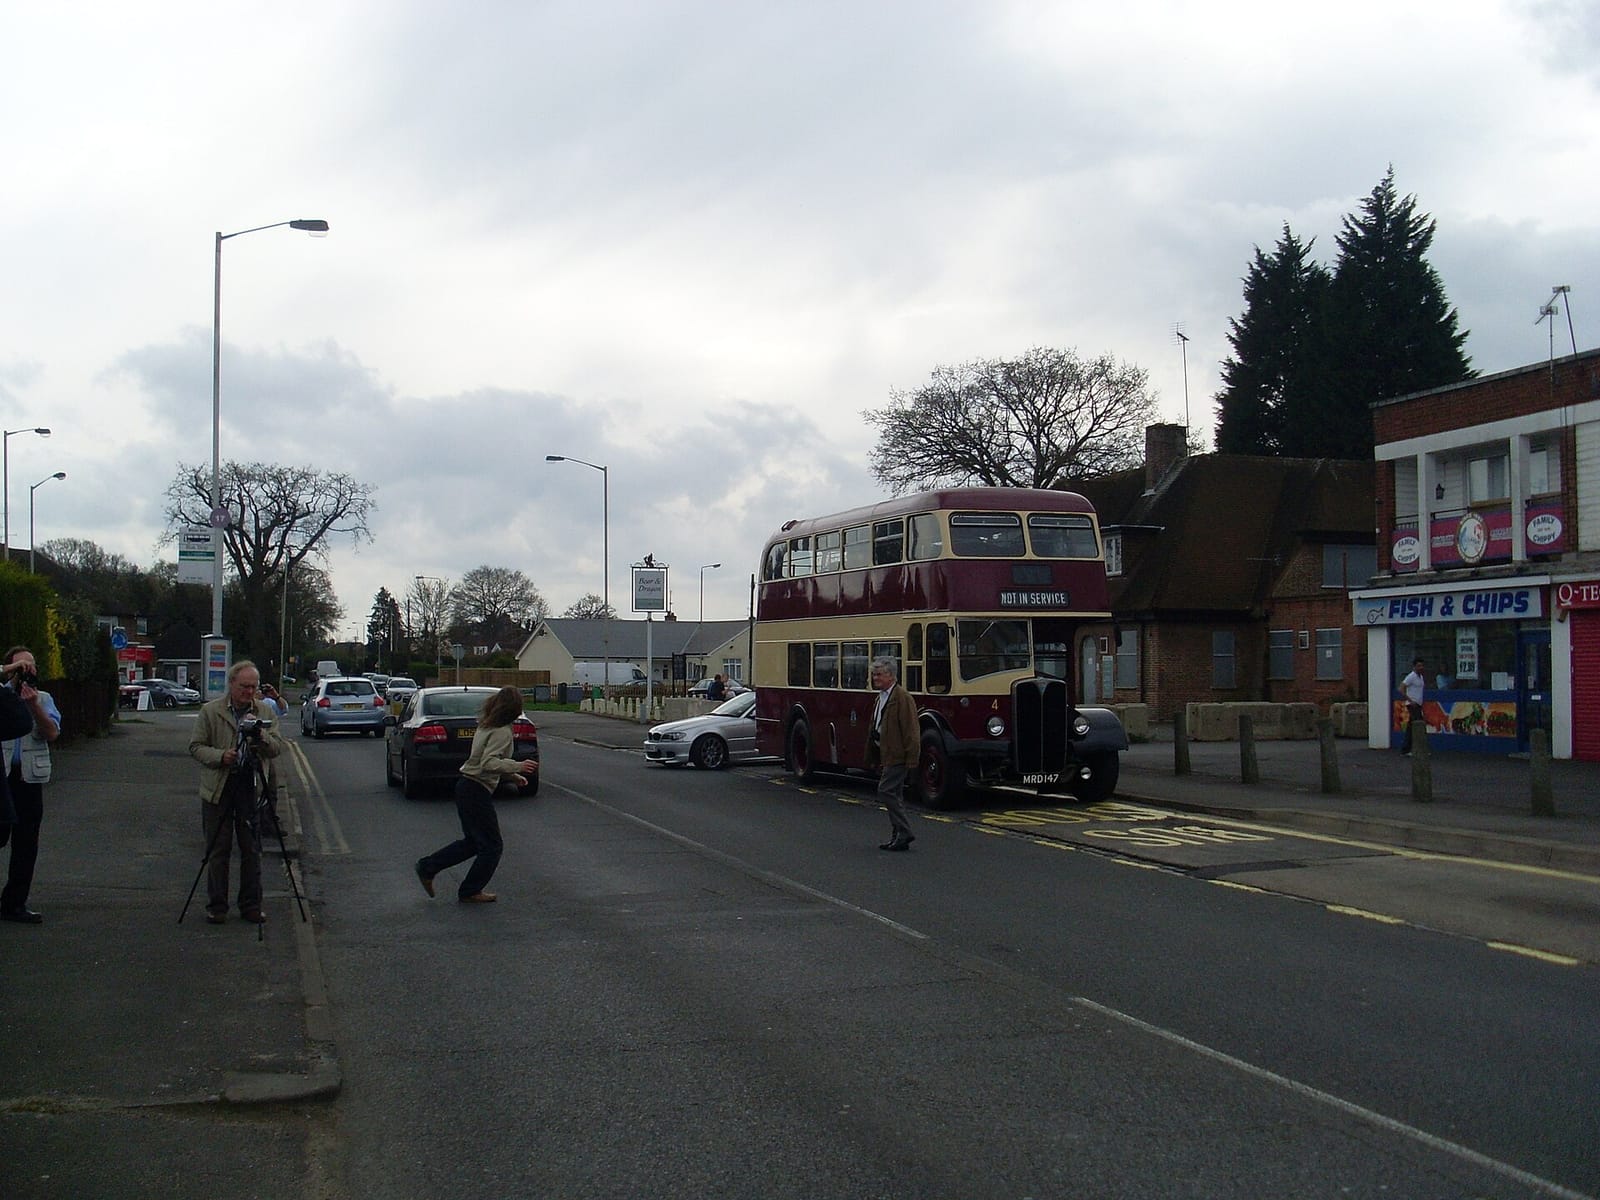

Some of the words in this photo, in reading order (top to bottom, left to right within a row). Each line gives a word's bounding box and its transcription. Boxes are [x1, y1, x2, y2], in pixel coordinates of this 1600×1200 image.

[1533, 516, 1555, 528] FAMILY
[1001, 592, 1016, 604] NOT
[1019, 592, 1028, 604] IN
[1030, 592, 1067, 604] SERVICE
[1558, 583, 1600, 606] Q-TE
[1388, 597, 1434, 619] FISH
[1440, 595, 1454, 617] &
[1462, 591, 1529, 615] CHIPS
[991, 699, 999, 711] 4
